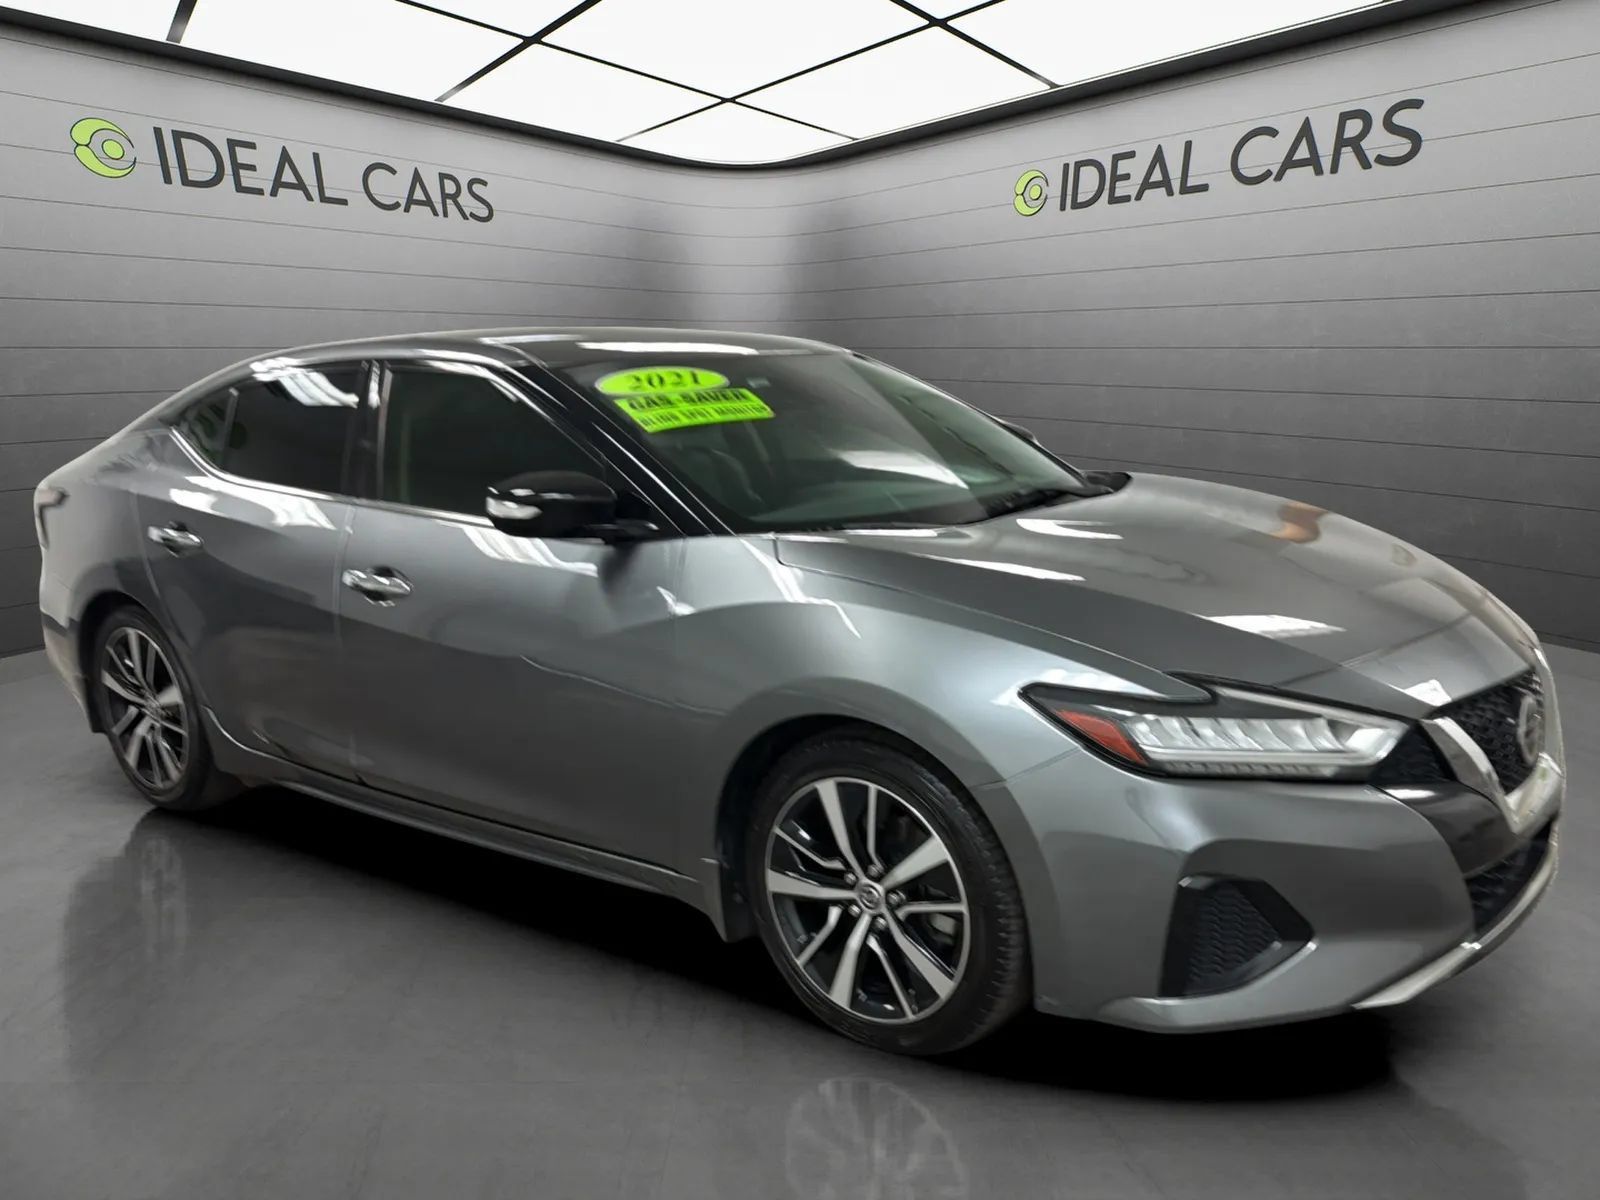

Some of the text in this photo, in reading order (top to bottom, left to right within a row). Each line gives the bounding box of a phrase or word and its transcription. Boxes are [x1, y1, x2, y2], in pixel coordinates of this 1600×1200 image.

[153, 126, 494, 222] IDEAL CARS
[1059, 98, 1425, 212] IDEAL CARS
[629, 370, 702, 390] 2021
